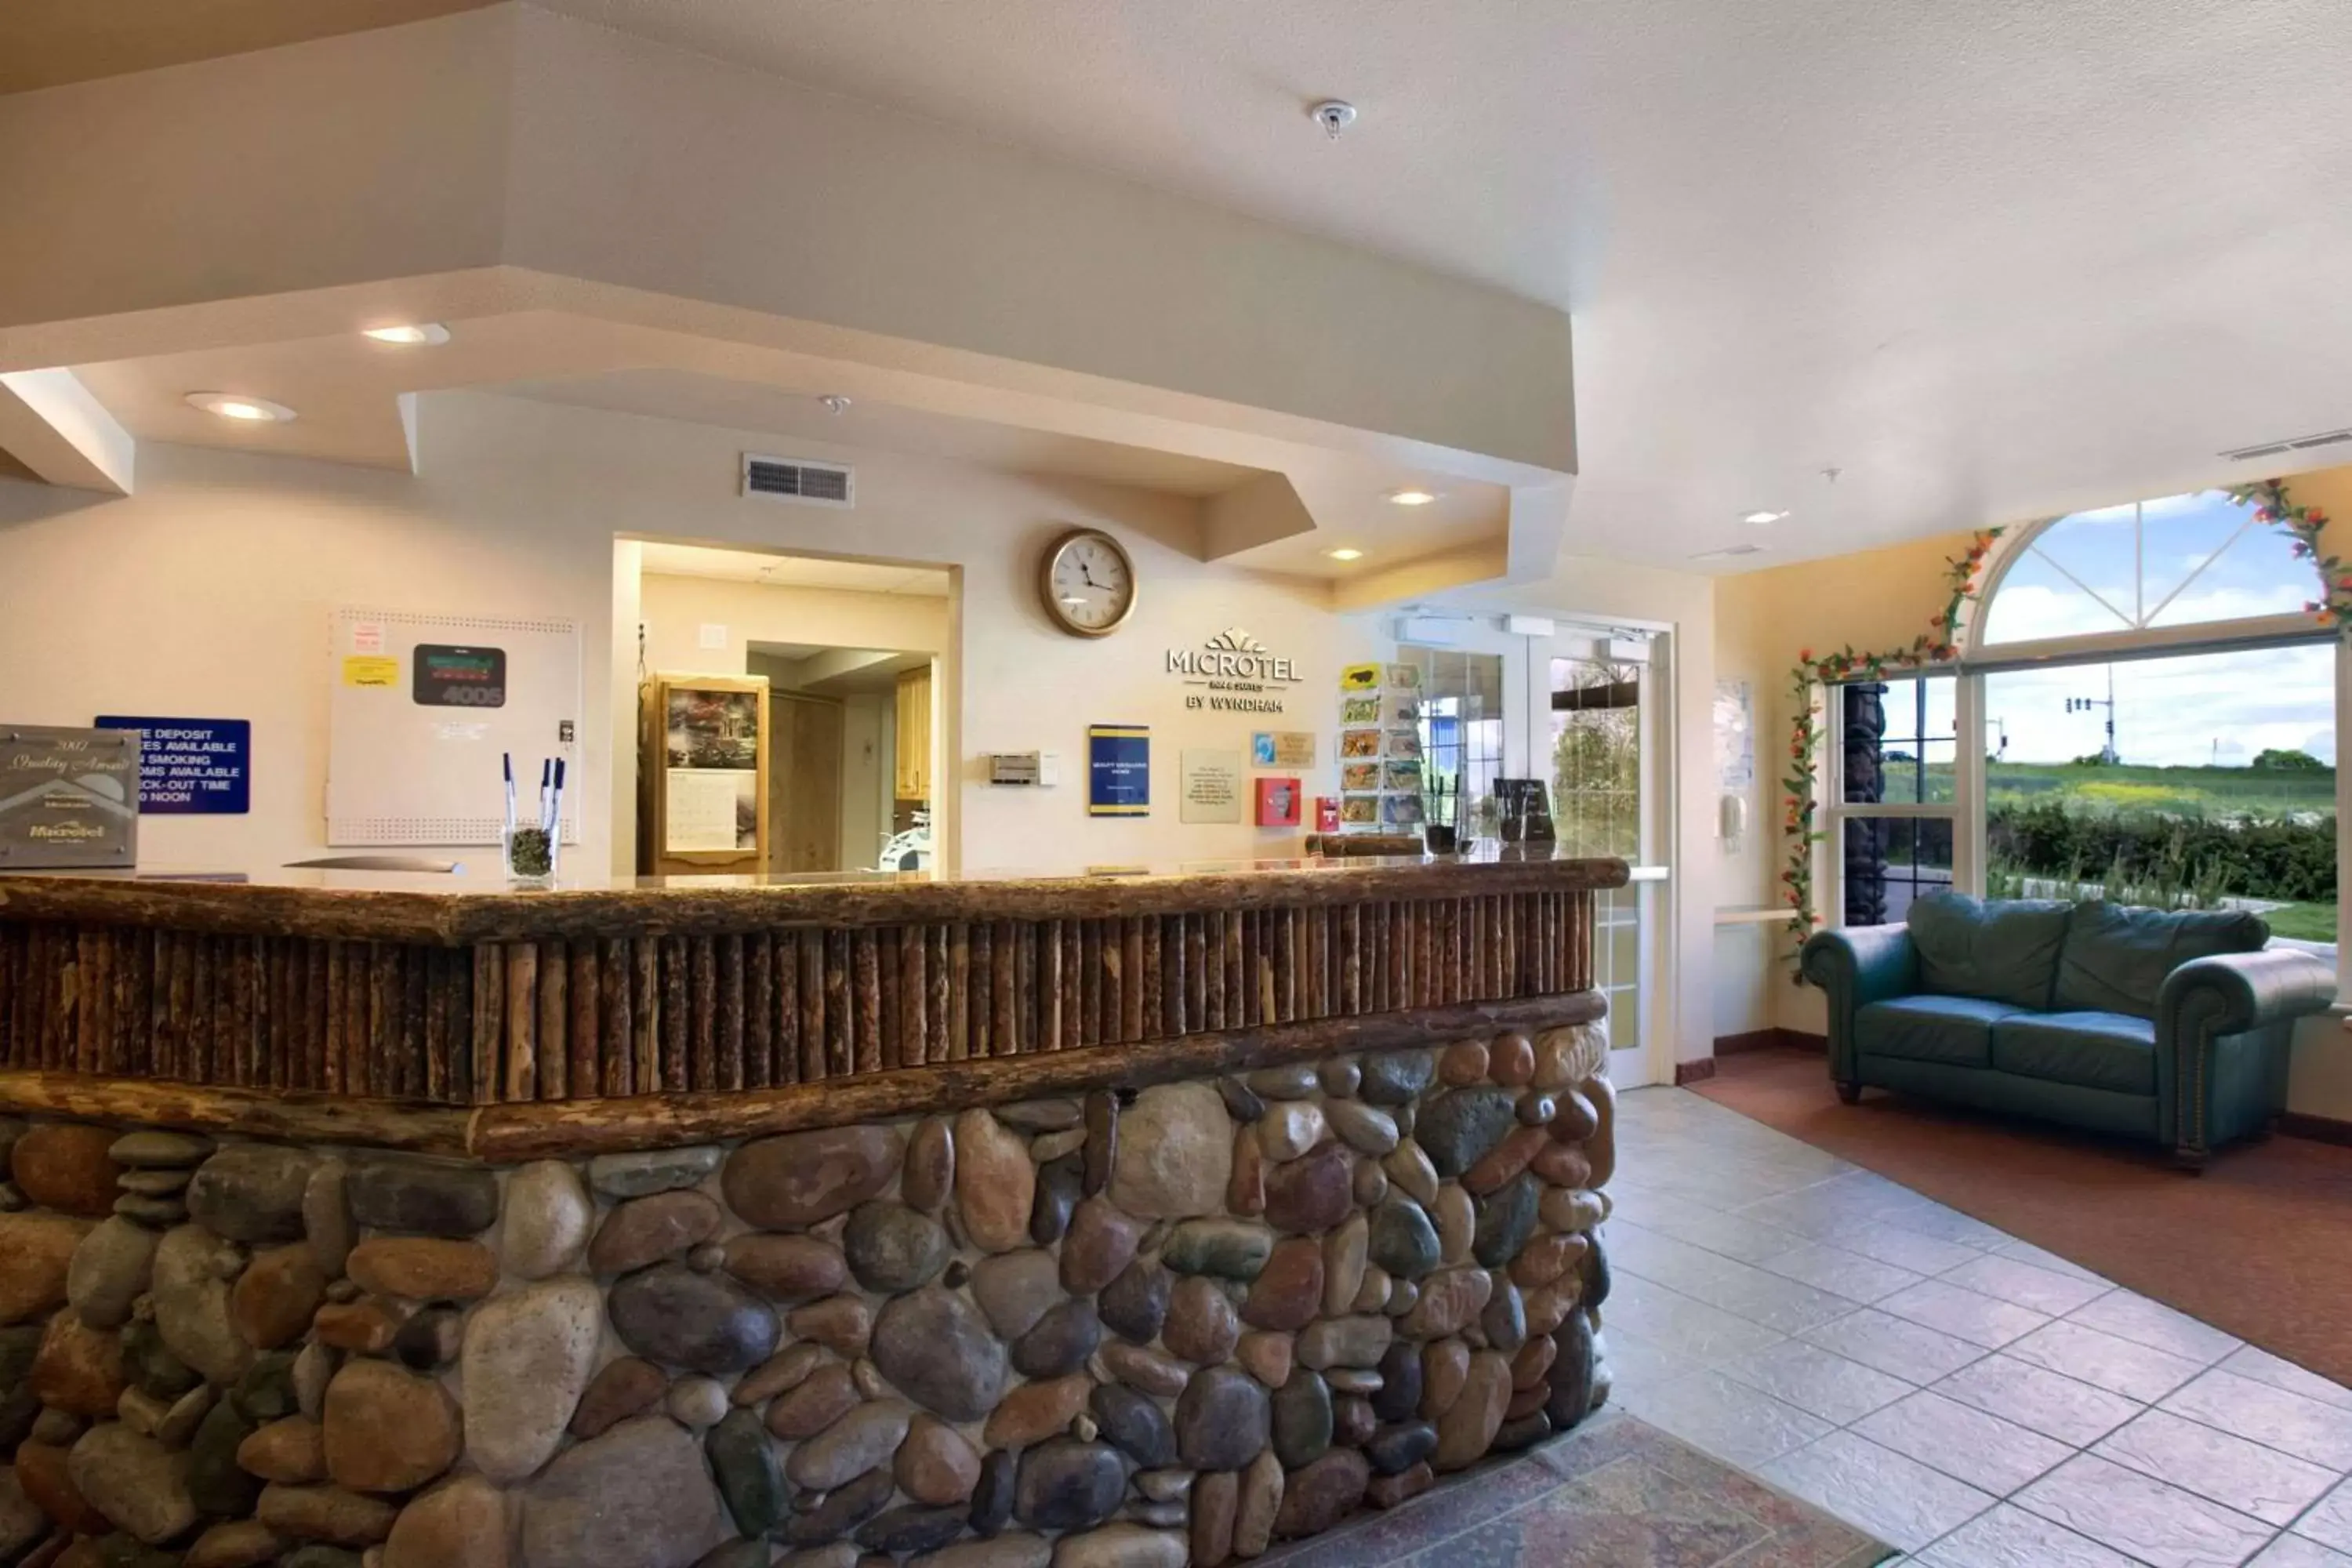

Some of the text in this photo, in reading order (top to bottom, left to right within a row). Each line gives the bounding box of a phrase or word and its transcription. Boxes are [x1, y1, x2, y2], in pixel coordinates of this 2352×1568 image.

[1167, 648, 1304, 681] MICROTEL
[1185, 695, 1283, 713] BY WYNDHAM
[154, 729, 213, 740] DEPOSIT
[165, 742, 237, 753] AVAILABLE
[7, 755, 68, 774] Quality
[147, 754, 211, 765] SMOKING
[169, 767, 239, 778] AVAILABLE
[199, 780, 231, 791] TIME
[150, 793, 191, 802] NOON
